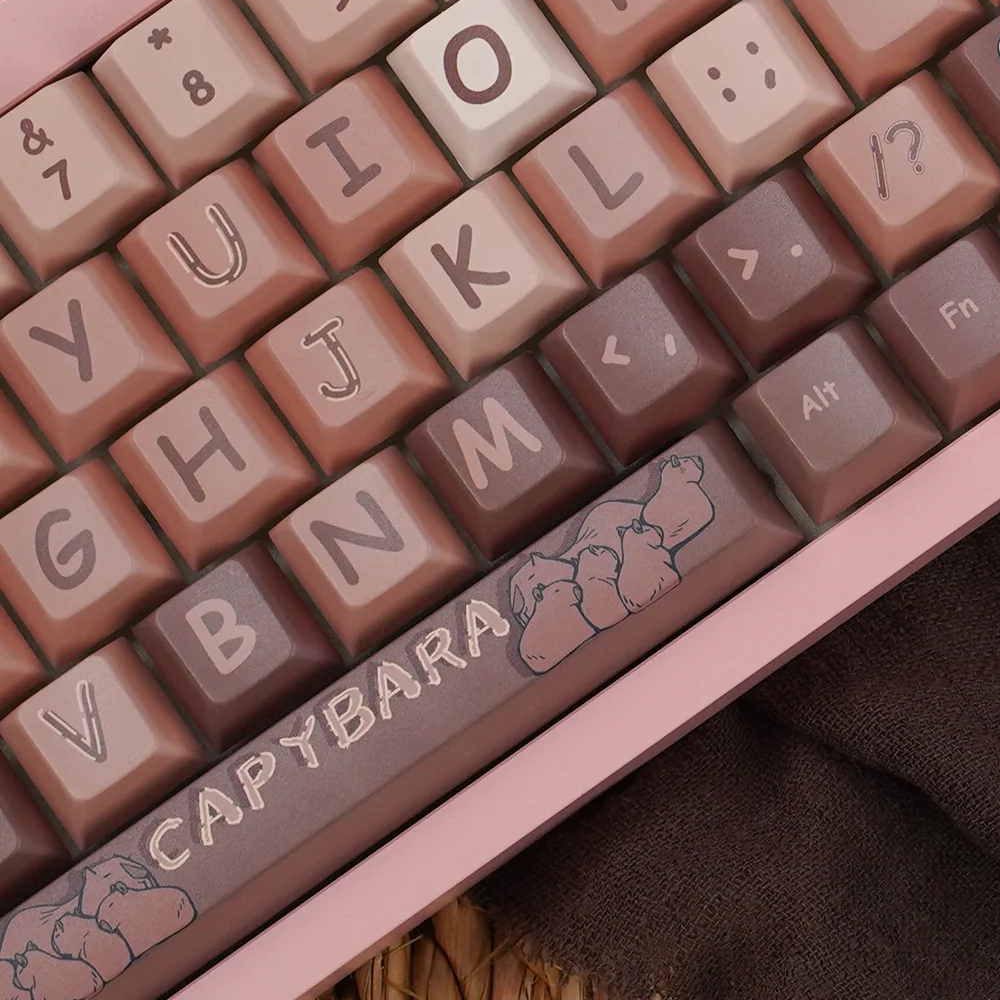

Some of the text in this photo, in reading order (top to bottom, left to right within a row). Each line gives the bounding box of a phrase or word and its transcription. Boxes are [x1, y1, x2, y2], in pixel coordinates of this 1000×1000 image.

[182, 69, 216, 106] 8
[443, 24, 513, 105] O
[42, 159, 72, 200] 7
[305, 116, 382, 197] I
[567, 144, 645, 211] L
[166, 202, 248, 289] U
[430, 223, 511, 309] K
[29, 299, 93, 382] Y
[938, 295, 980, 331] Fn
[300, 315, 361, 401] J
[800, 378, 840, 421] Alt
[157, 406, 247, 503] H
[452, 397, 543, 490] M
[34, 507, 97, 591] G
[309, 490, 405, 586] N
[184, 597, 257, 676] B
[37, 679, 109, 764] V
[149, 599, 511, 871] CAPYBARA
